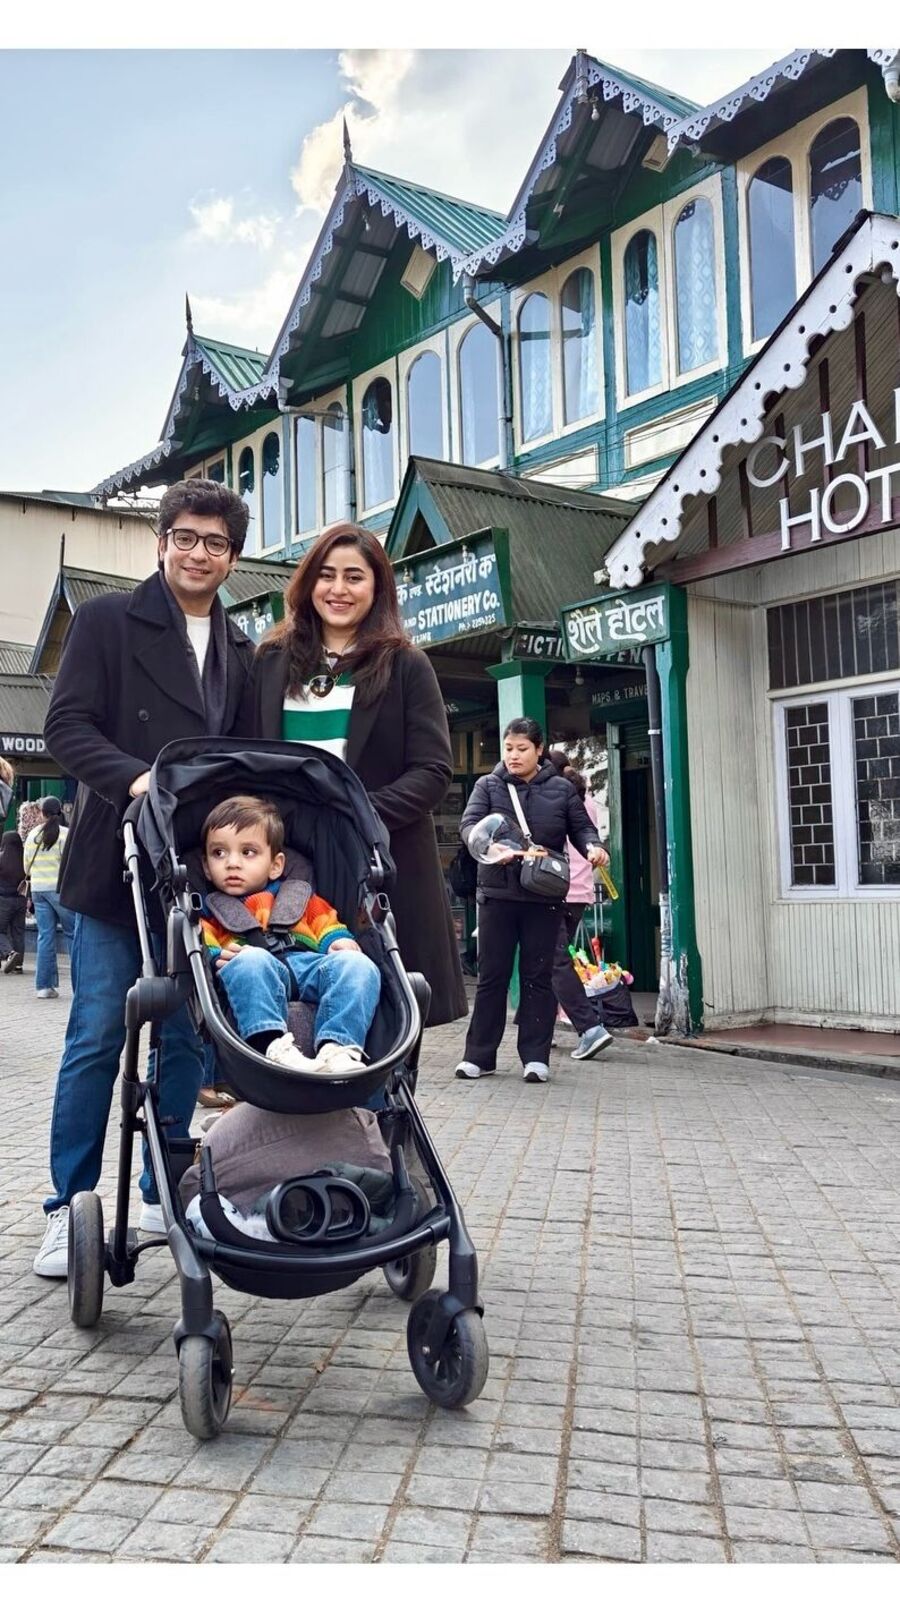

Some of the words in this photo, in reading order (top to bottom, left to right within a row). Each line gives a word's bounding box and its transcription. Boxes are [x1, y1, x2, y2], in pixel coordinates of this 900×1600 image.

[746, 387, 900, 488] CHA
[779, 462, 900, 551] HOT
[418, 591, 483, 631] STATIONERY
[567, 607, 603, 654] शैले
[604, 595, 665, 642] होटल
[2, 736, 46, 752] WOOD
